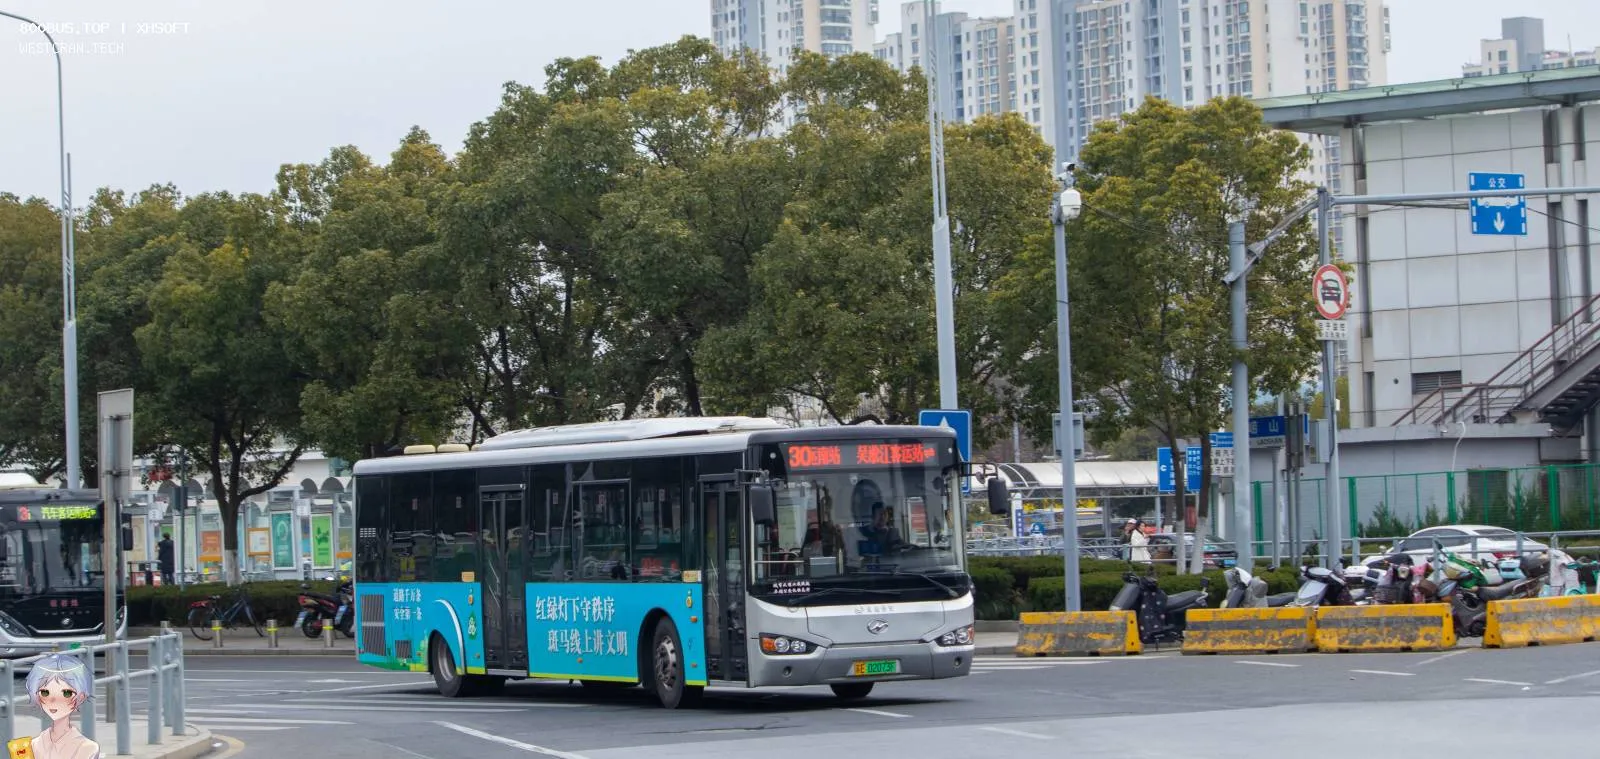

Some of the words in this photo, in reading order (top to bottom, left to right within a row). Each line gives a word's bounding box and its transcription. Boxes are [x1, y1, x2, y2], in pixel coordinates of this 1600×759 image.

[1488, 177, 1506, 188] 公交
[393, 588, 421, 603] 道路千万条
[393, 607, 422, 621] 安全第一条
[535, 595, 616, 622] 红绿灯下守秩序
[547, 629, 629, 656] 斑马线上讲文明
